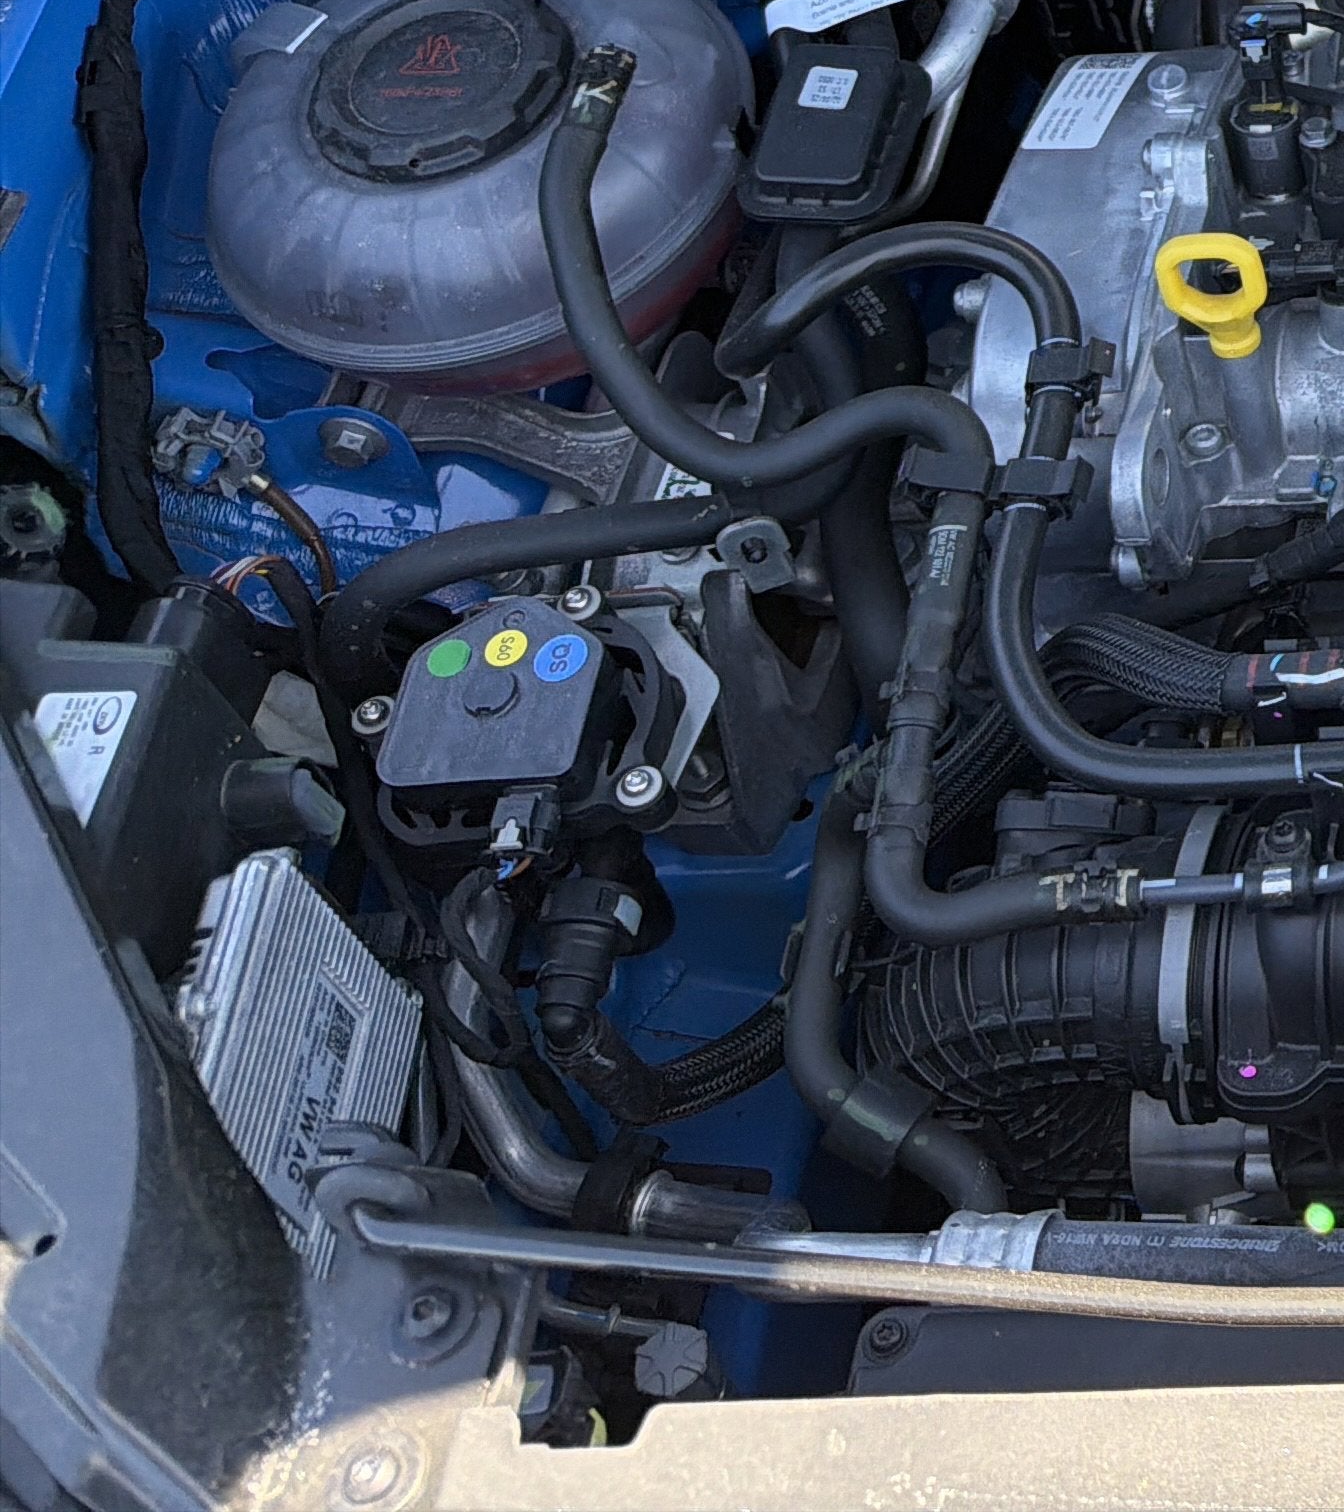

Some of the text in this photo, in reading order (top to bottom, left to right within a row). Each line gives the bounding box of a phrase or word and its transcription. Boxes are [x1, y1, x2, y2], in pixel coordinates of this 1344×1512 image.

[549, 641, 573, 673] SQ
[286, 1096, 321, 1185] VW AG
